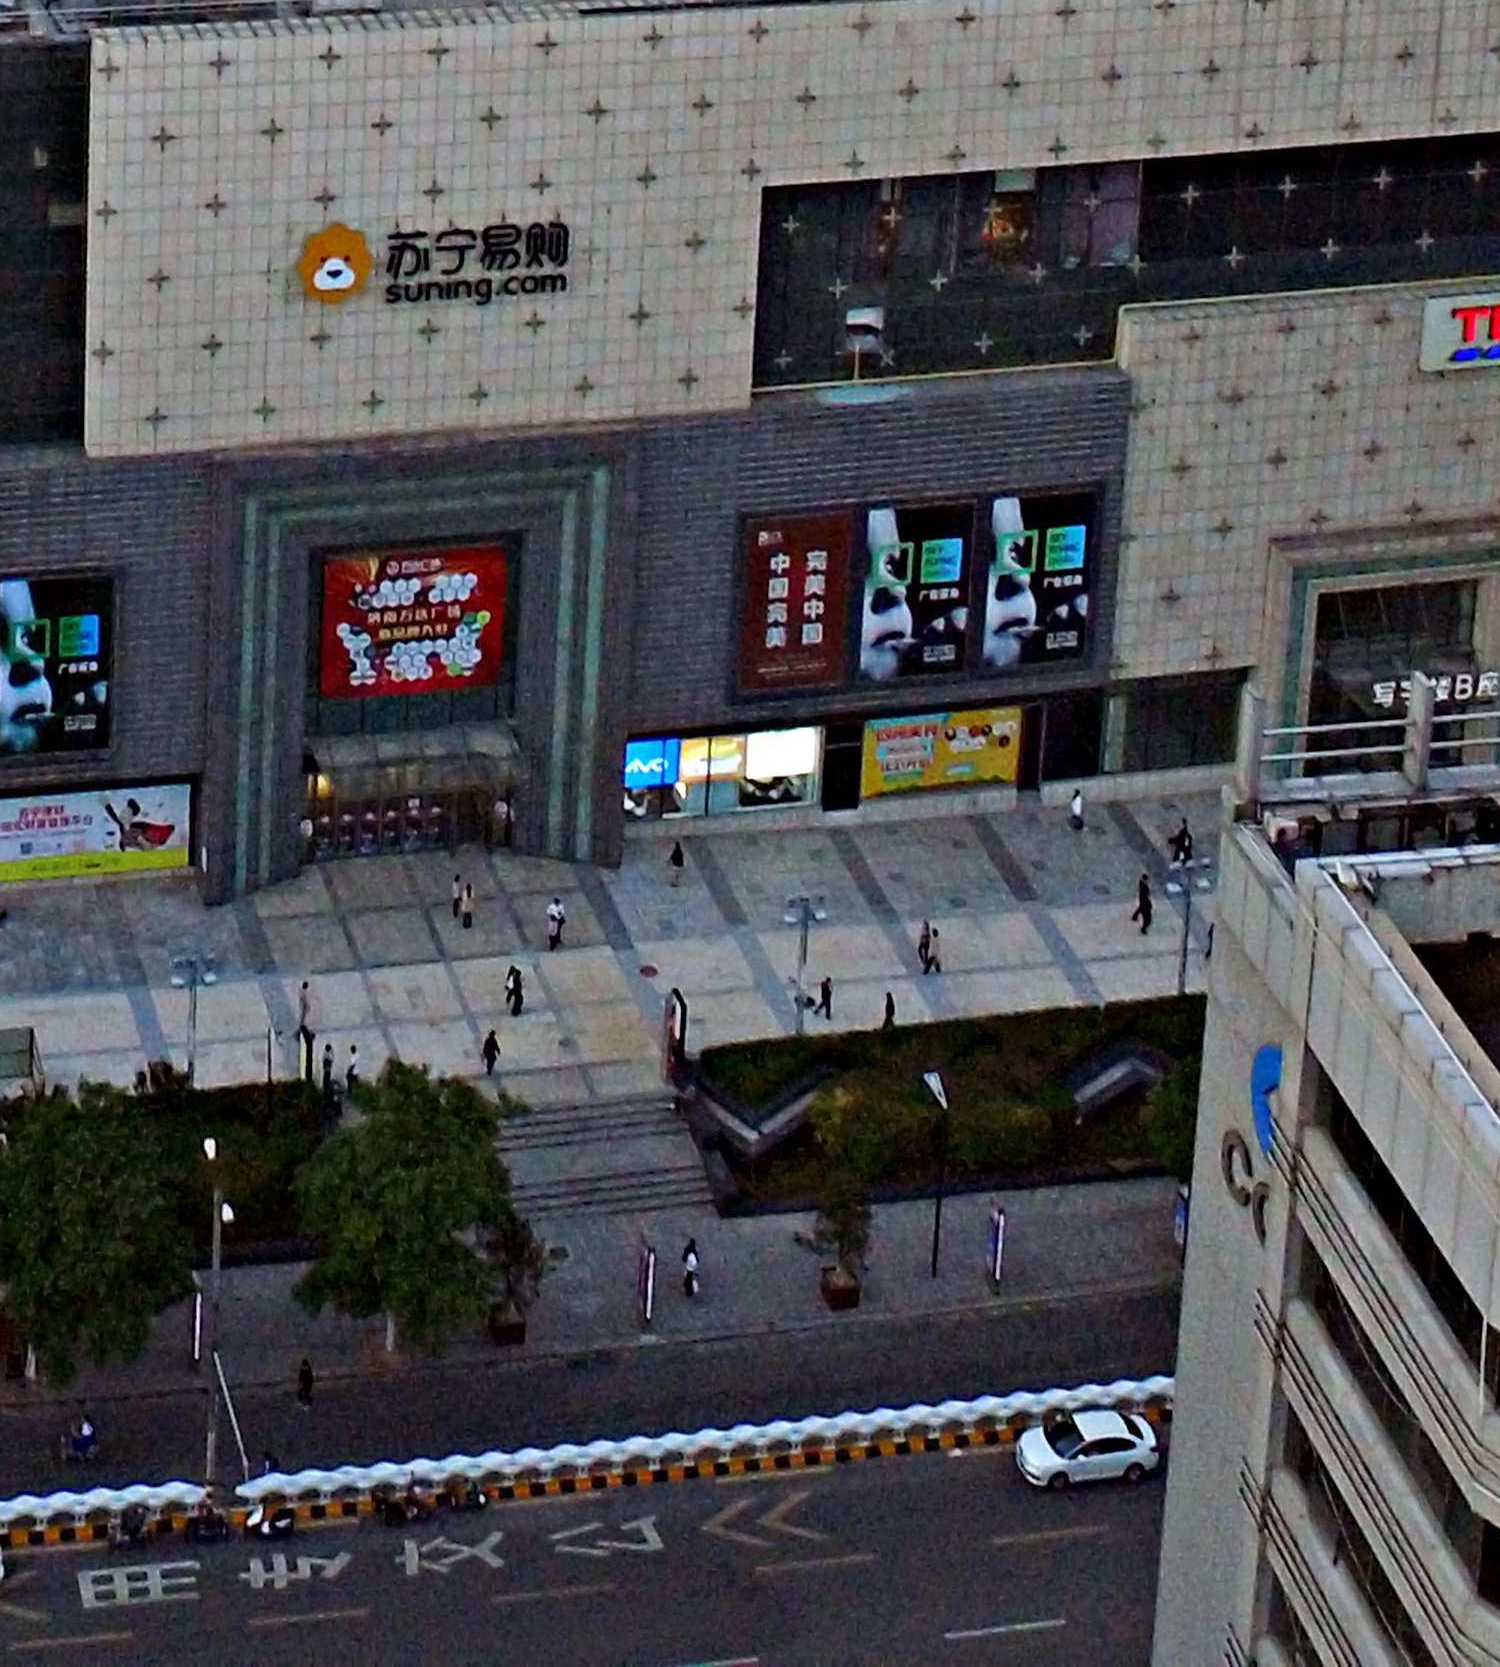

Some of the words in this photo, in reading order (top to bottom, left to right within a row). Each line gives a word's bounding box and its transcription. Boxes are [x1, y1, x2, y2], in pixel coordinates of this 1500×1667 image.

[386, 221, 569, 279] 苏宁易购
[385, 273, 567, 306] suning.com
